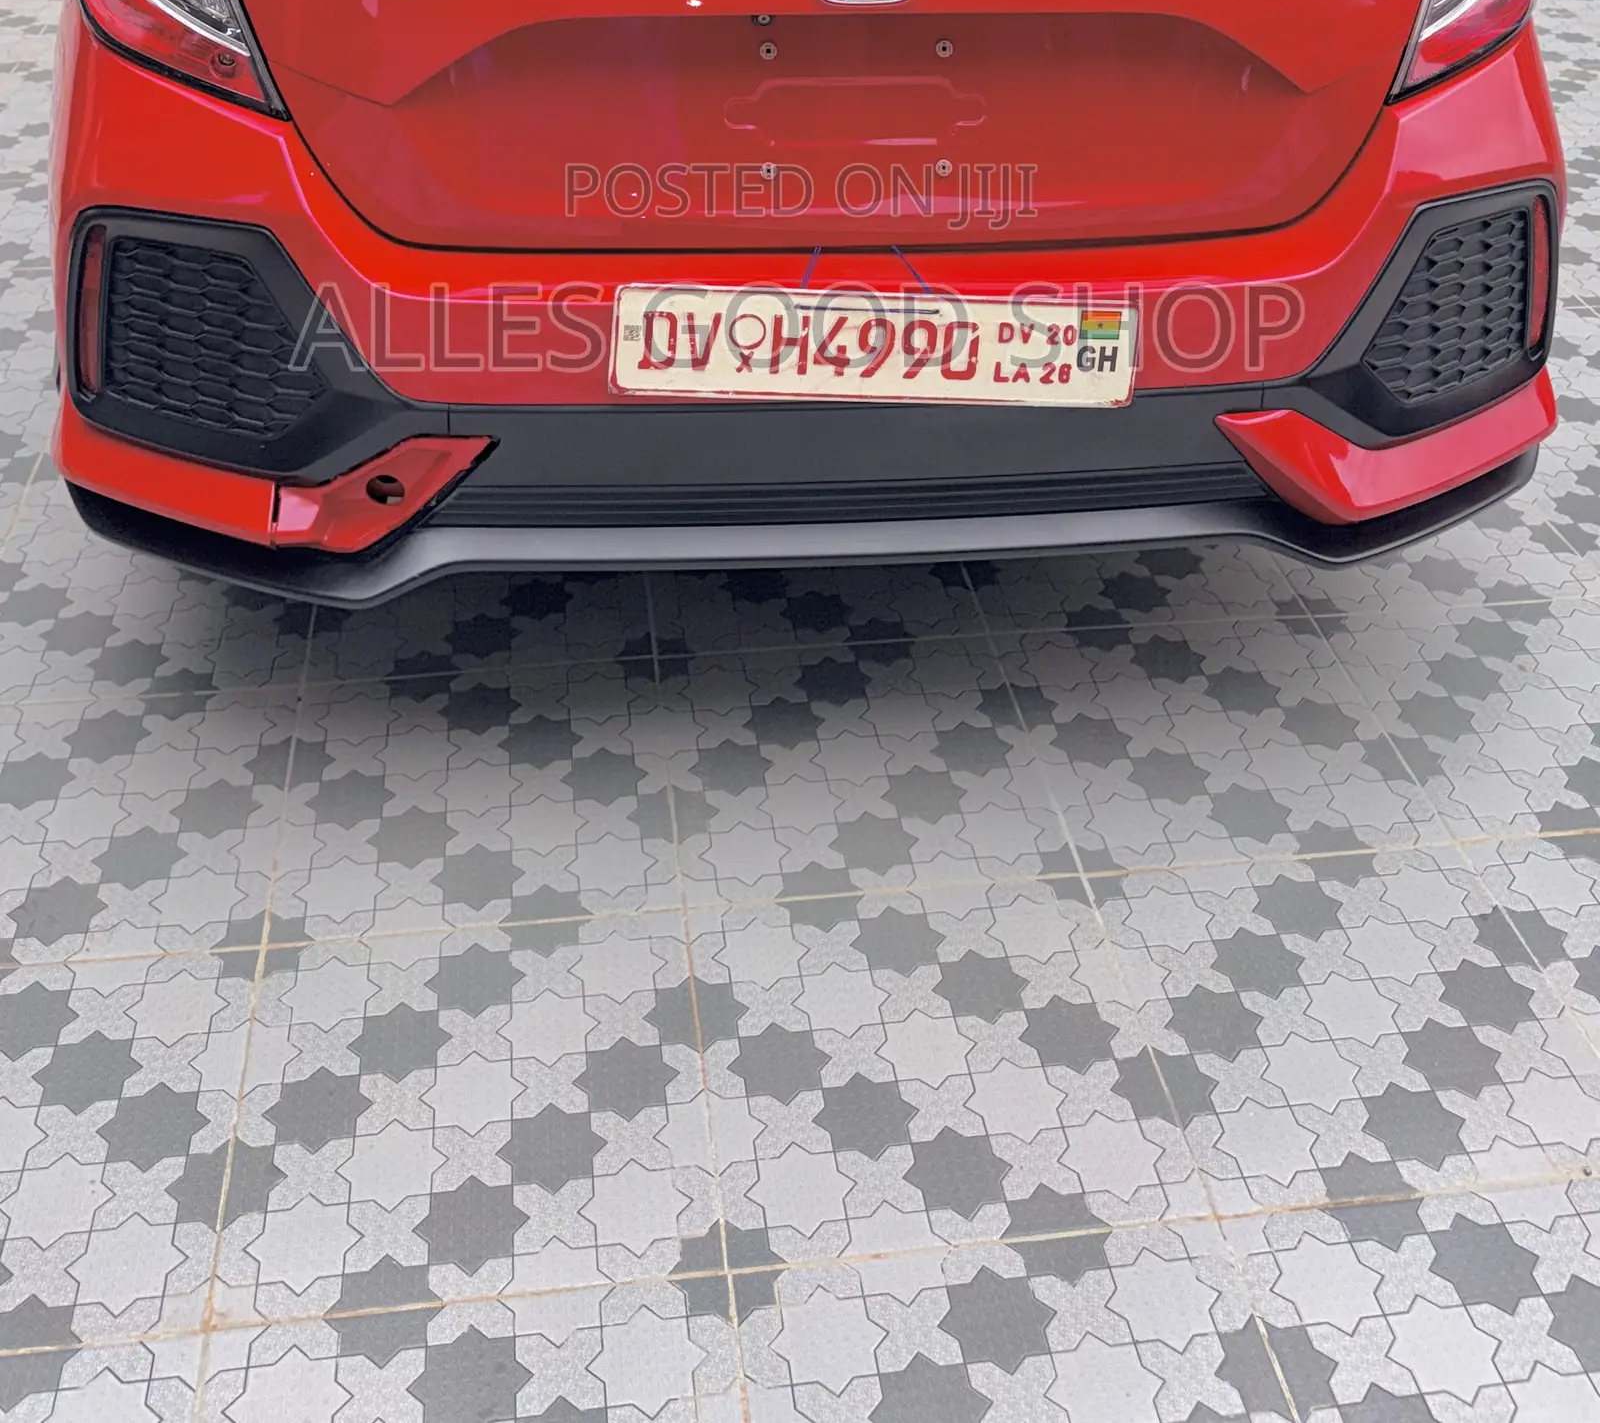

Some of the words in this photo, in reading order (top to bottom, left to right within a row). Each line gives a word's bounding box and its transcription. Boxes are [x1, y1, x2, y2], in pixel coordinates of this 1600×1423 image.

[998, 322, 1034, 344] DV
[1046, 323, 1077, 346] 20
[1076, 345, 1118, 372] GH
[993, 361, 1030, 383] LA
